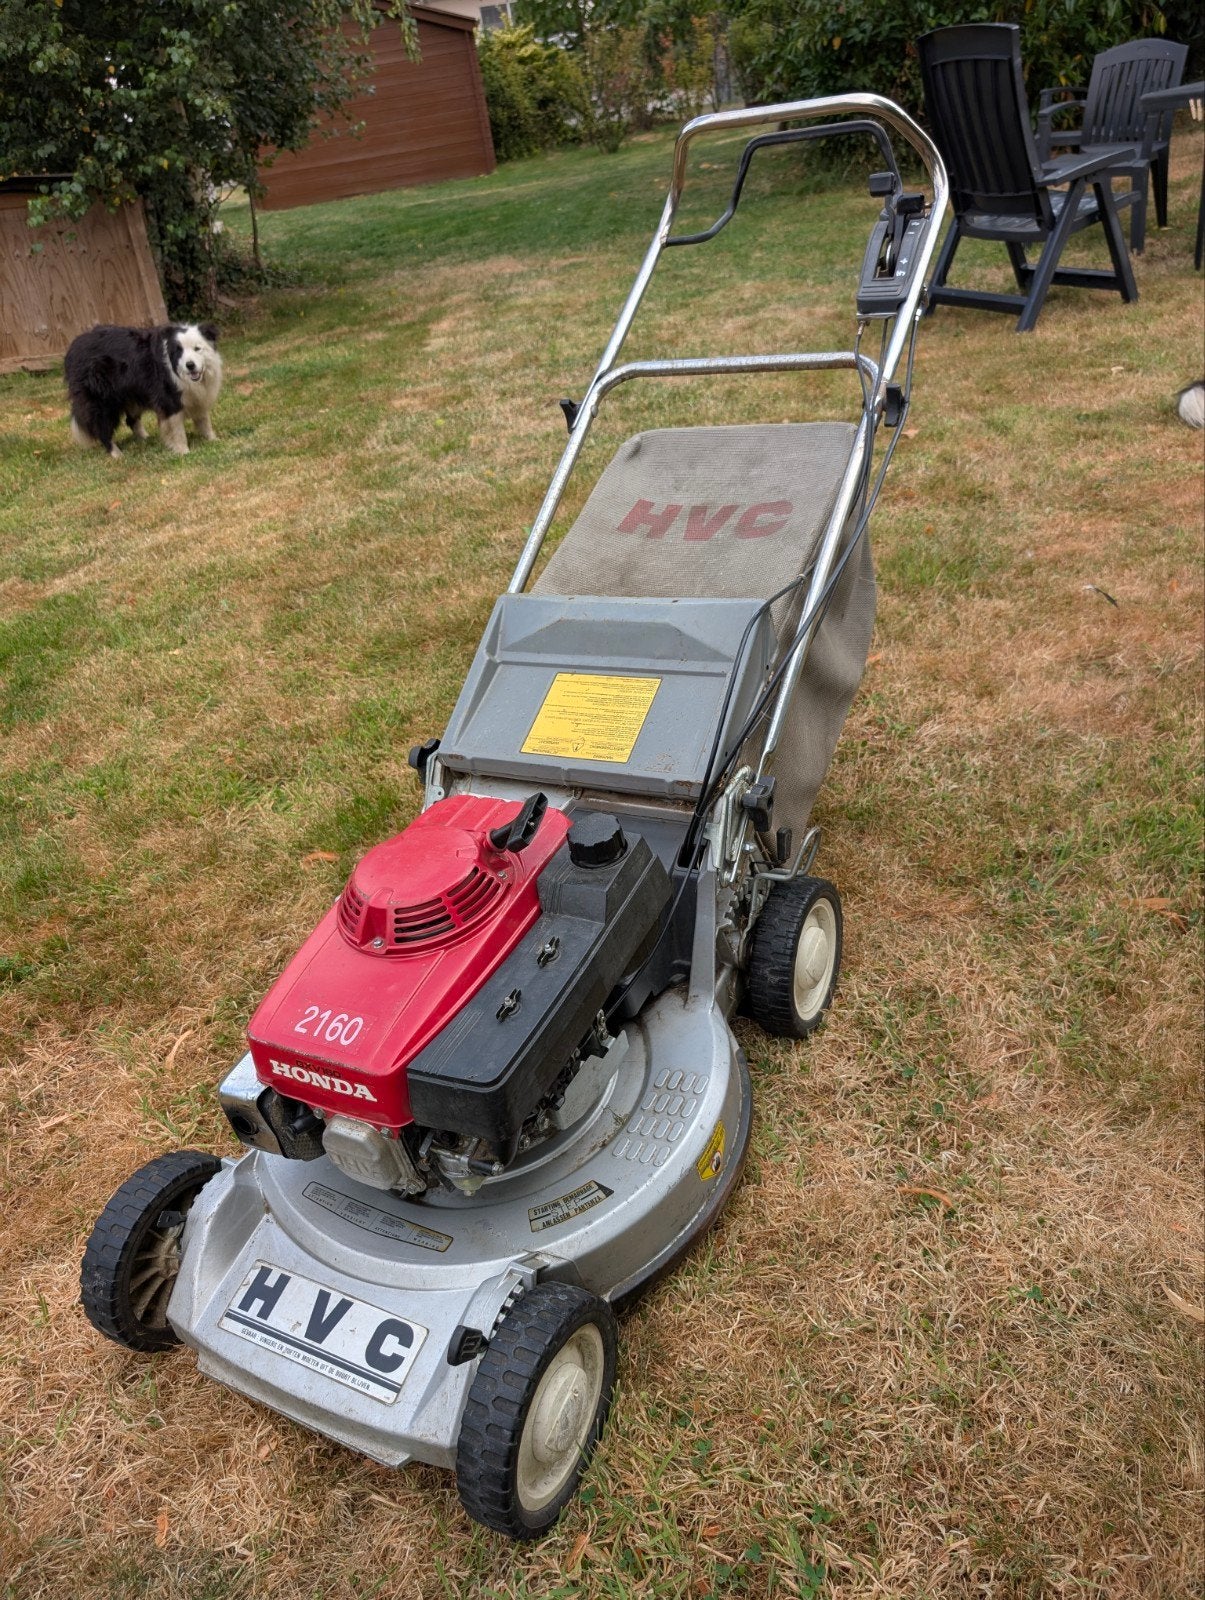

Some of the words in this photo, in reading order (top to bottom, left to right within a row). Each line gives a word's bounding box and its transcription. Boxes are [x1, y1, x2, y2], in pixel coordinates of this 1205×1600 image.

[617, 498, 794, 541] HVC
[294, 1005, 364, 1046] 2160
[269, 1059, 378, 1102] HONDA
[533, 1200, 561, 1216] STARTING
